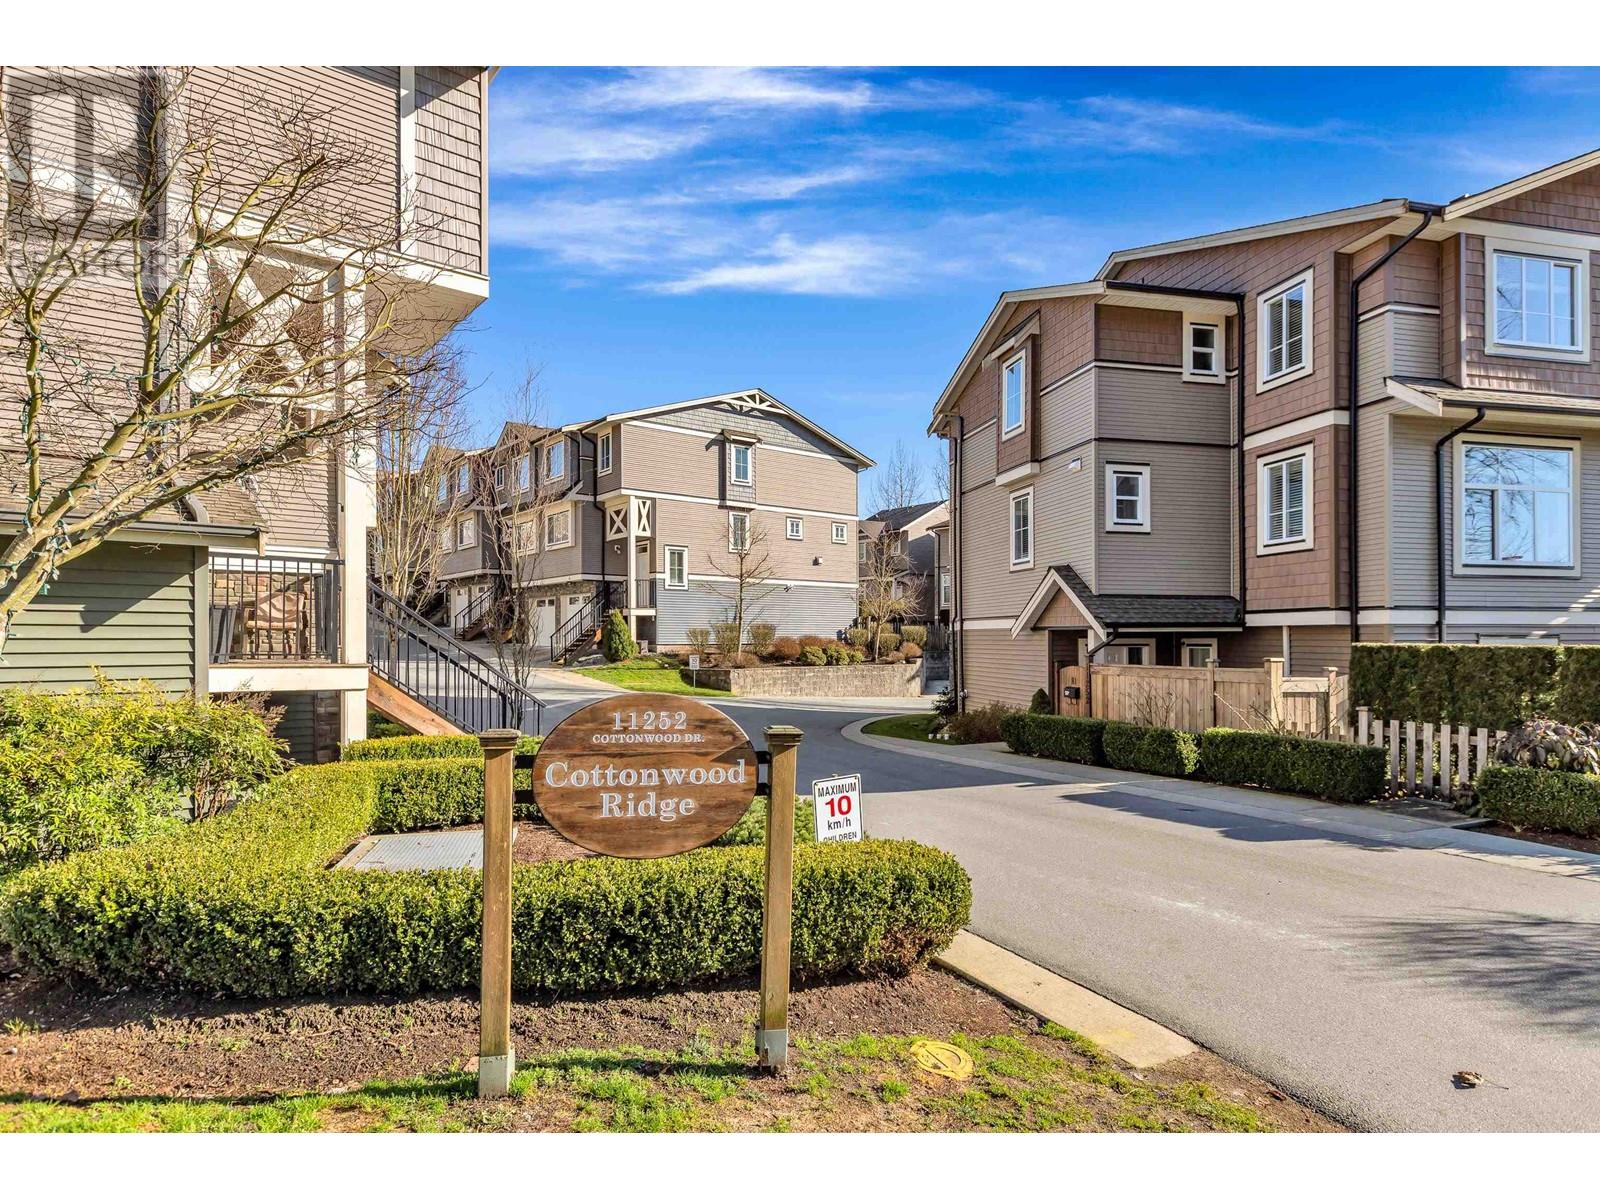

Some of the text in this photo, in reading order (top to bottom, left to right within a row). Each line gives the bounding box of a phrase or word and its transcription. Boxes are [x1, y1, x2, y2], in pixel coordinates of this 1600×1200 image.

[612, 711, 687, 730] 11252
[592, 733, 681, 744] COTTONWOOD
[545, 759, 746, 788] Cottonwood
[817, 782, 857, 798] MAXIMUM
[600, 791, 695, 822] Ridge
[825, 795, 852, 817] 10
[827, 816, 852, 831] km/h
